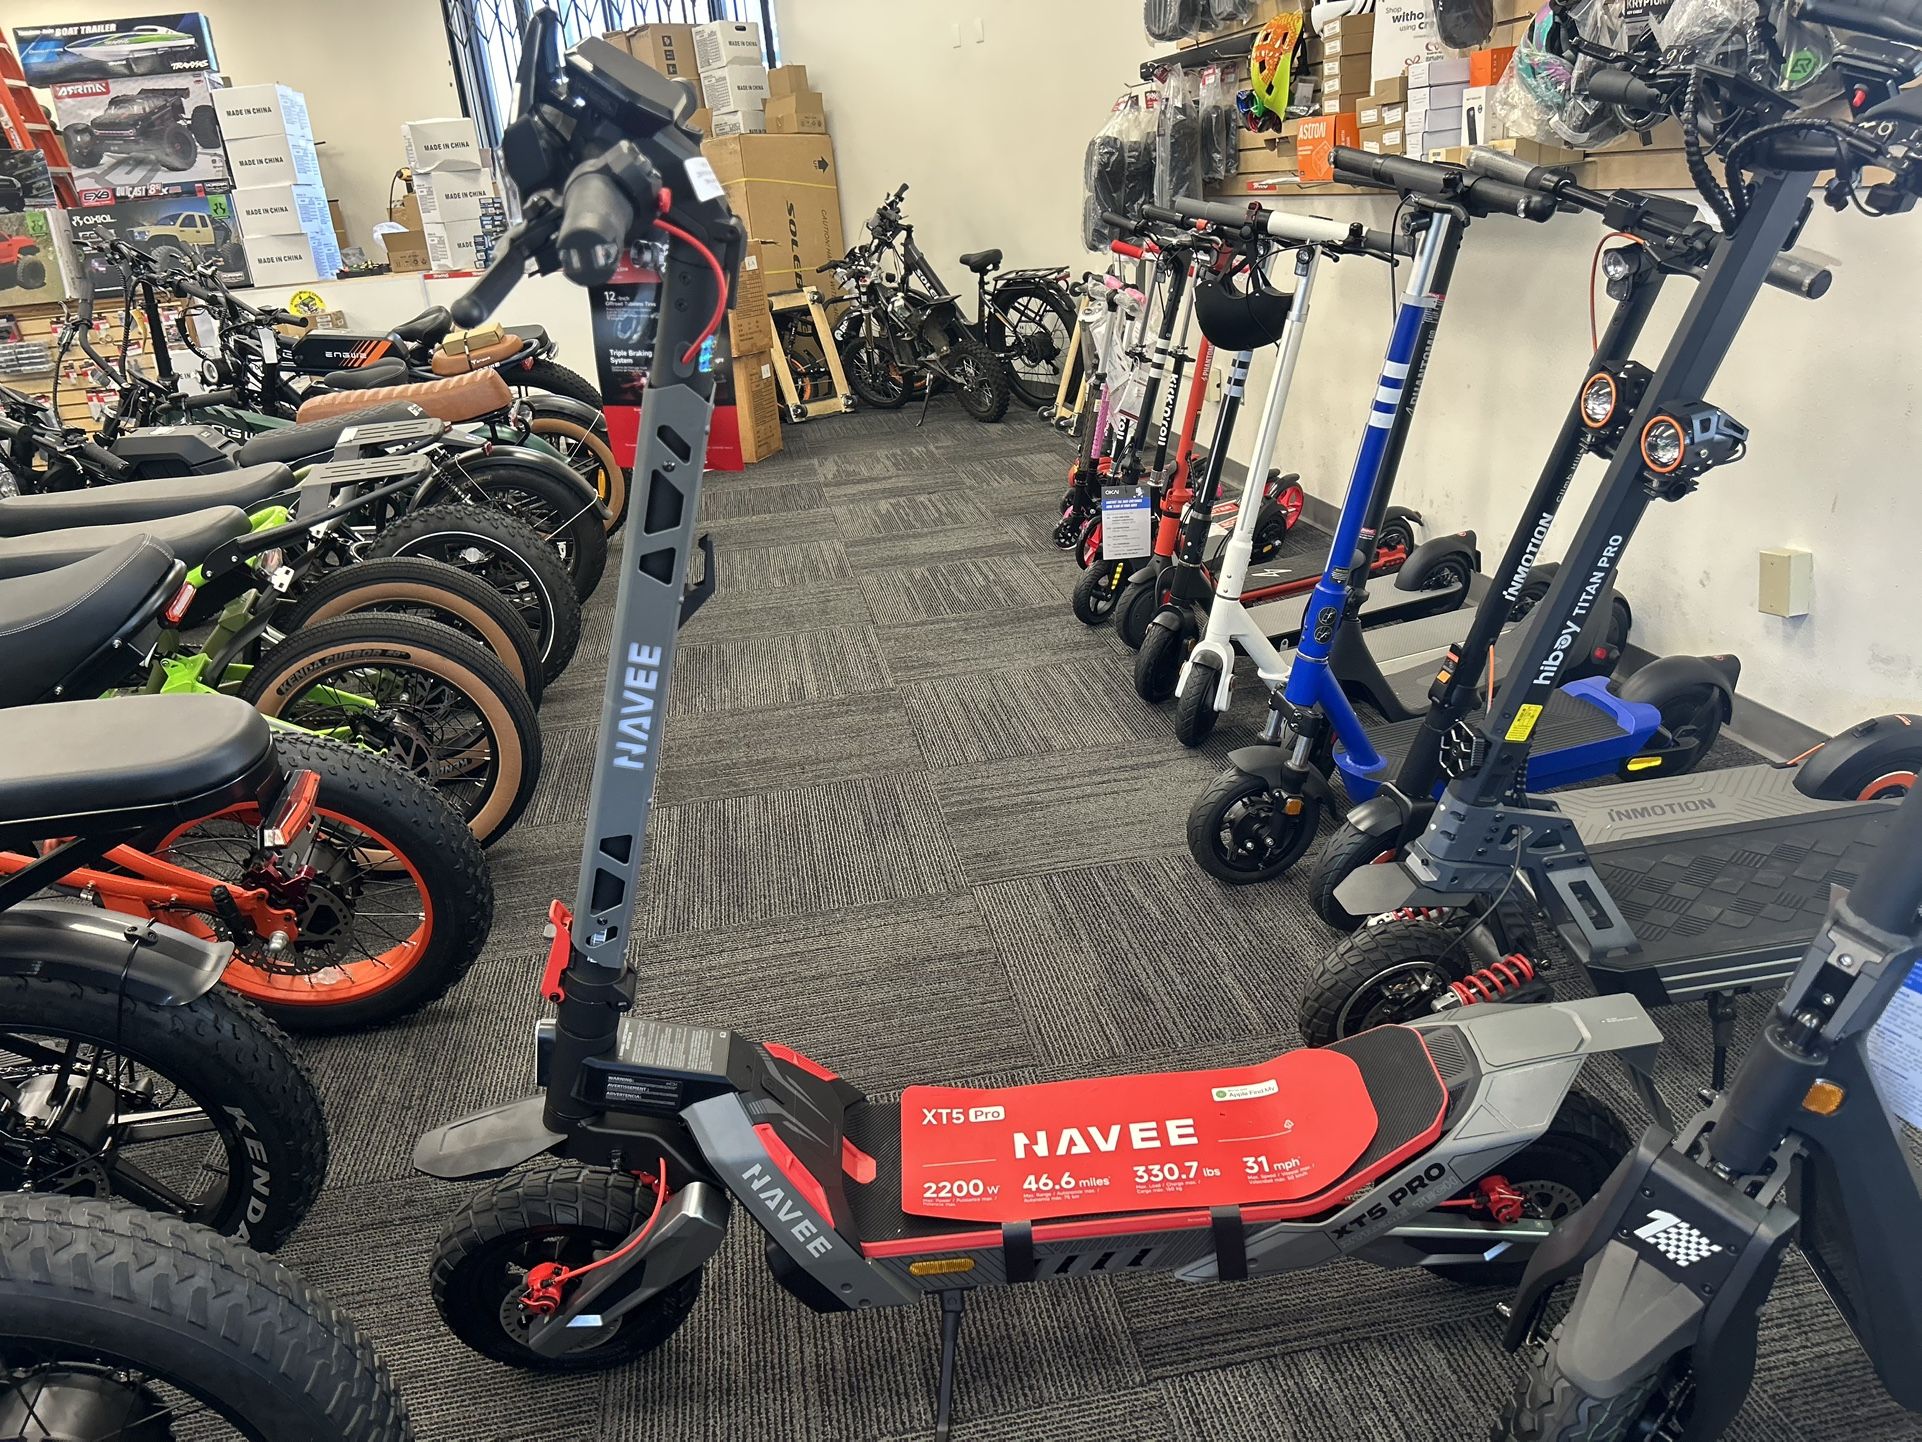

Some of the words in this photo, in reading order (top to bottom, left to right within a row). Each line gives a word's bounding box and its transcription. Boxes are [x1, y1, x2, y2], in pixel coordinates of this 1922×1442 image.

[55, 27, 79, 36] BOAT
[79, 24, 117, 34] TRAILER
[1400, 24, 1416, 32] using
[226, 108, 244, 117] MADE
[252, 106, 272, 114] CHINA
[424, 144, 442, 152] MADE
[443, 142, 450, 150] IN
[451, 141, 470, 149] CHINA
[238, 158, 256, 166] MADE
[264, 156, 284, 164] CHINA
[116, 186, 146, 200] OUTCAST
[469, 190, 486, 198] CHINA
[246, 208, 262, 216] MADE
[270, 206, 288, 214] CHINA
[258, 256, 275, 264] MADE
[283, 254, 303, 262] CHINA
[604, 292, 616, 301] 12
[609, 350, 628, 358] Triple
[628, 350, 652, 358] Braking
[1572, 571, 1605, 616] TITAN
[1598, 534, 1622, 569] PRO
[281, 661, 322, 693] KENDA
[612, 642, 662, 770] NAVEE
[922, 1108, 964, 1125] XT5
[974, 1110, 1000, 1120] Pro
[1013, 1118, 1198, 1158] NAVEE
[1132, 1161, 1198, 1183] 330.7
[1203, 1168, 1221, 1177] lbs
[1242, 1155, 1270, 1174] 31
[222, 1105, 272, 1243] KENDA
[1022, 1172, 1076, 1191] 46.6
[923, 1178, 984, 1198] 2200
[1331, 1202, 1388, 1240] XT5
[1388, 1162, 1446, 1208] PRO
[742, 1163, 832, 1258] NAVEE
